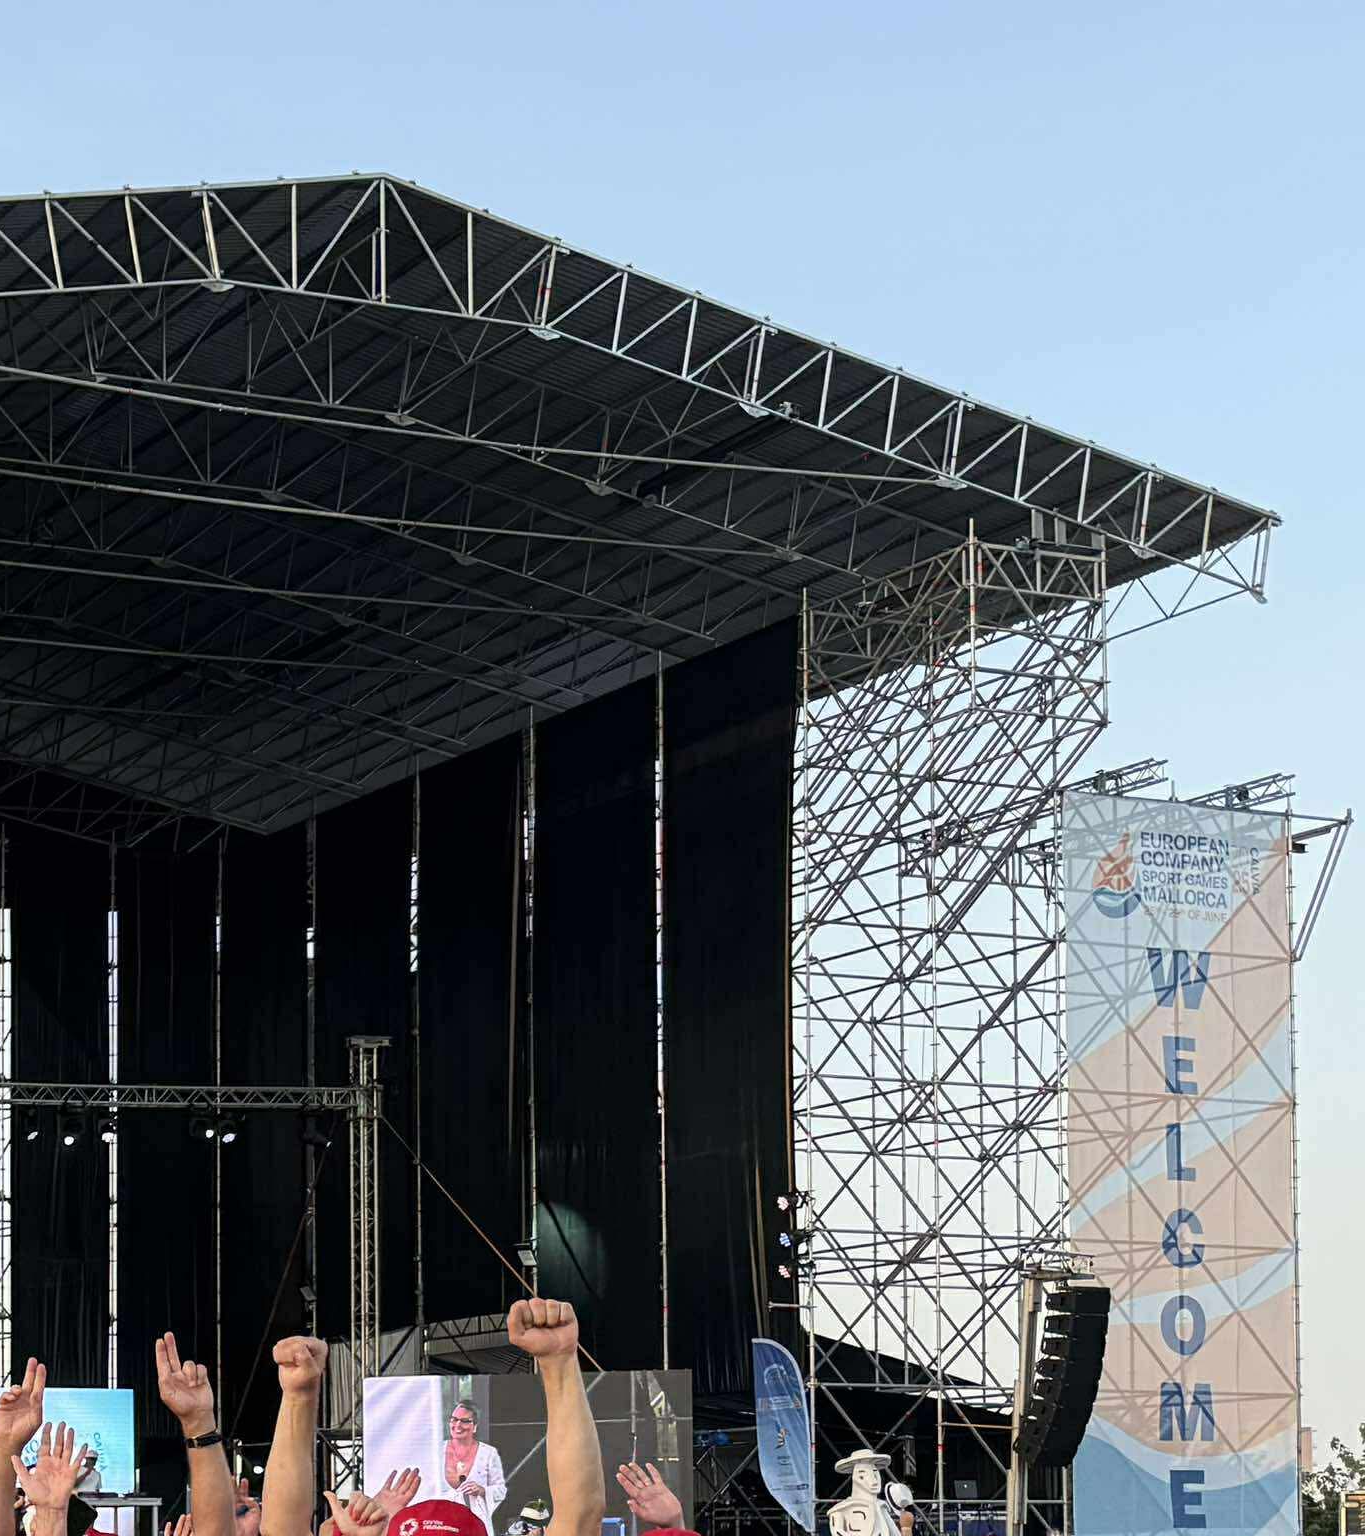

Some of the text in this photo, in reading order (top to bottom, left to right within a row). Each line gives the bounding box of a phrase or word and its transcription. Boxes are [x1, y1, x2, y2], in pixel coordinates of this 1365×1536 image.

[1140, 831, 1229, 856] EUROPEAN
[1141, 850, 1224, 873] COMPANY
[1142, 870, 1182, 885] SPORT
[1184, 874, 1228, 890] GAMES
[1143, 886, 1228, 909] MALLORCA
[1146, 946, 1216, 1529] WELCOME
